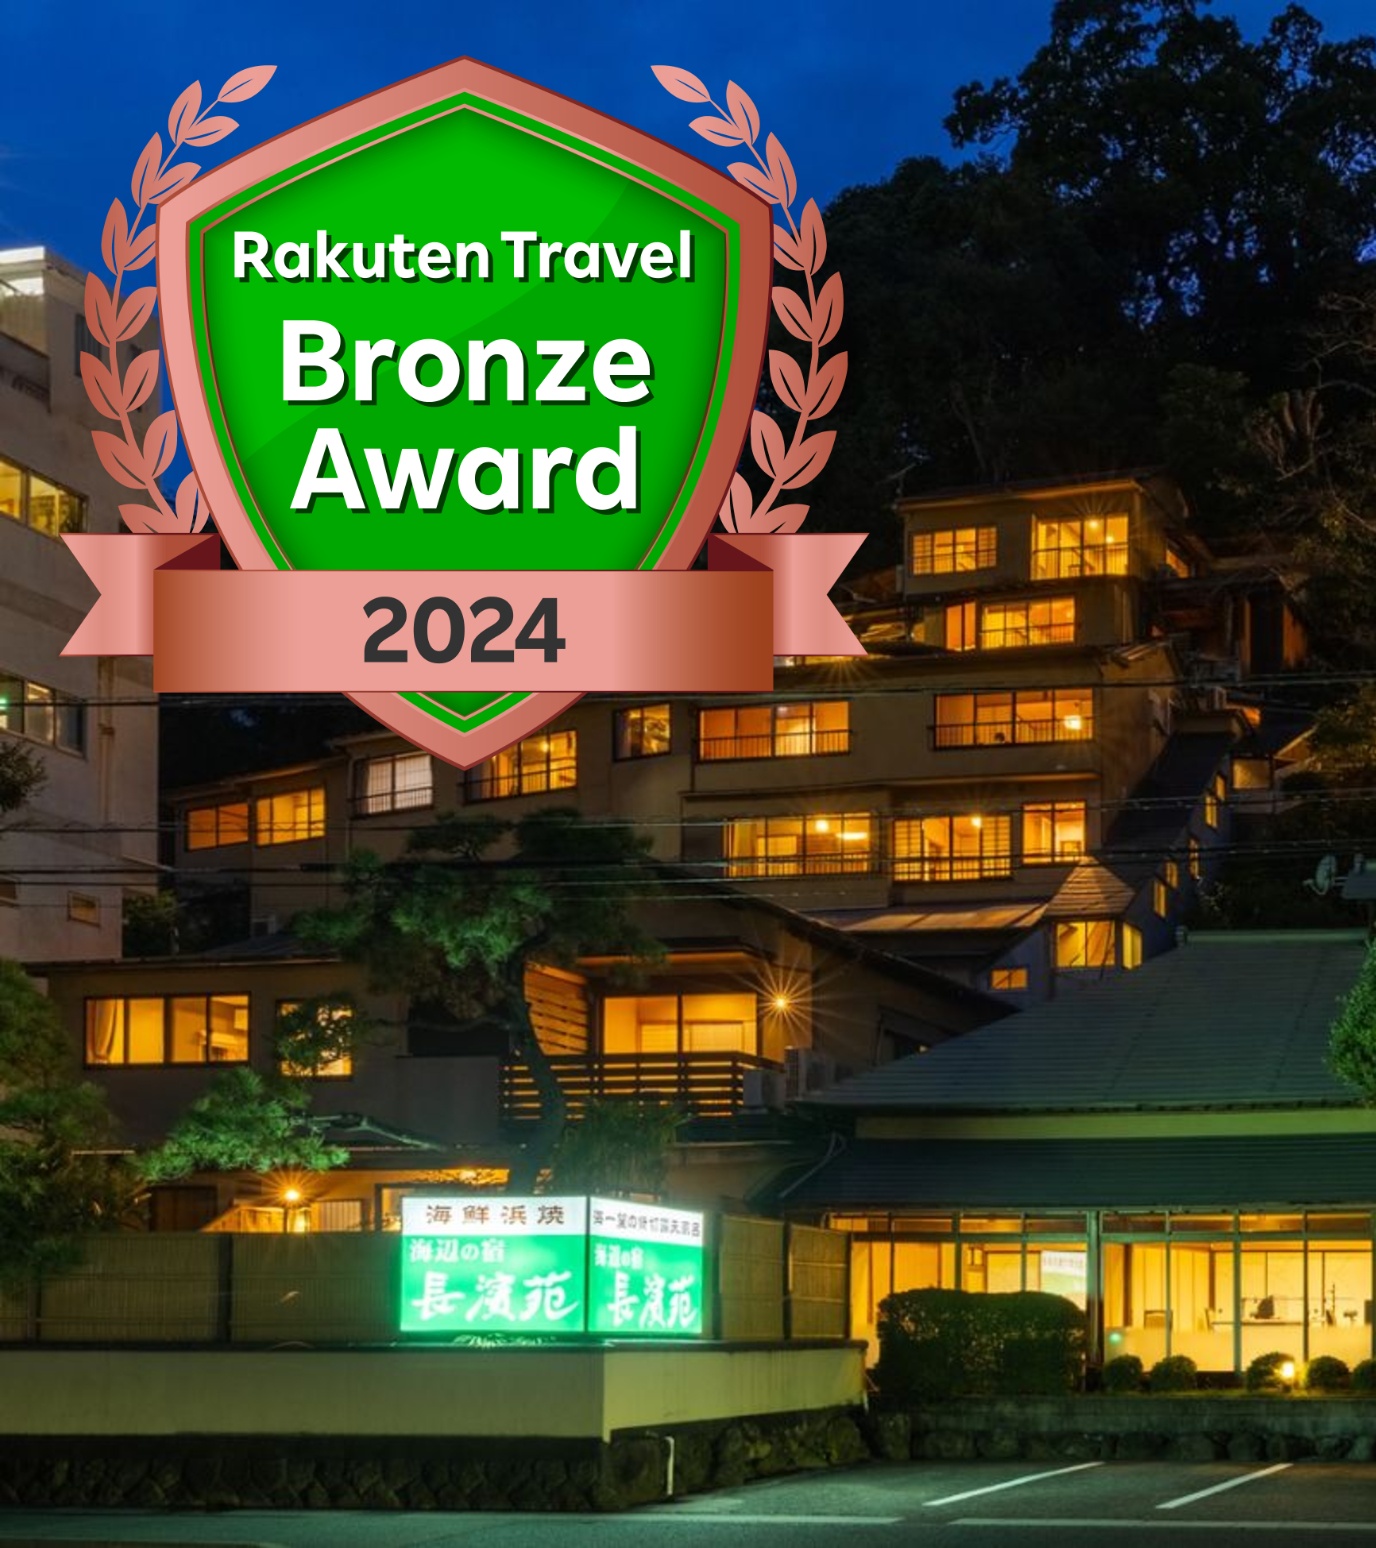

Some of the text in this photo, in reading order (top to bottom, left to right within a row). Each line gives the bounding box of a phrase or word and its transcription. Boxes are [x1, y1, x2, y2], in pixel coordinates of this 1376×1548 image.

[426, 1204, 565, 1225] 海鮮浜焼
[409, 1238, 505, 1263] 海辺の宿
